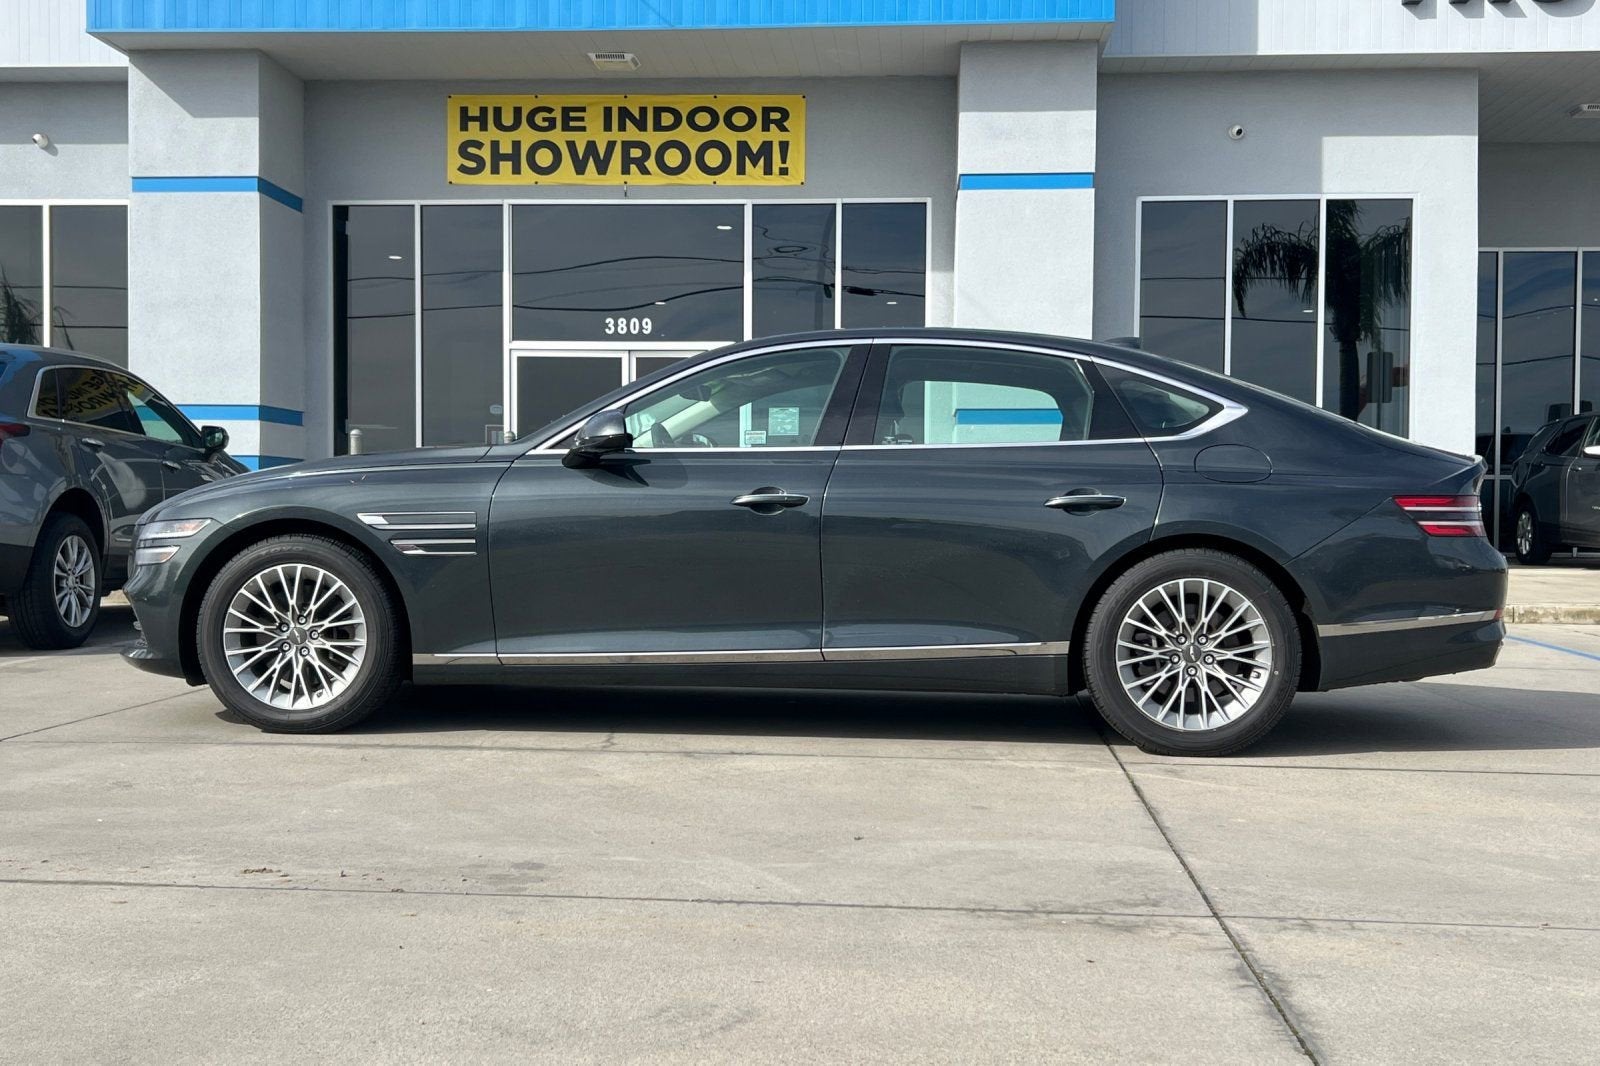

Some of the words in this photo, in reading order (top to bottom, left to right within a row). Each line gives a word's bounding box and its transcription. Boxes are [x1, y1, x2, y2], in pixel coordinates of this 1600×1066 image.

[459, 105, 587, 132] HUGE
[603, 105, 790, 132] INDOOR
[457, 139, 791, 176] SHOWROOM!
[605, 317, 652, 335] 3809
